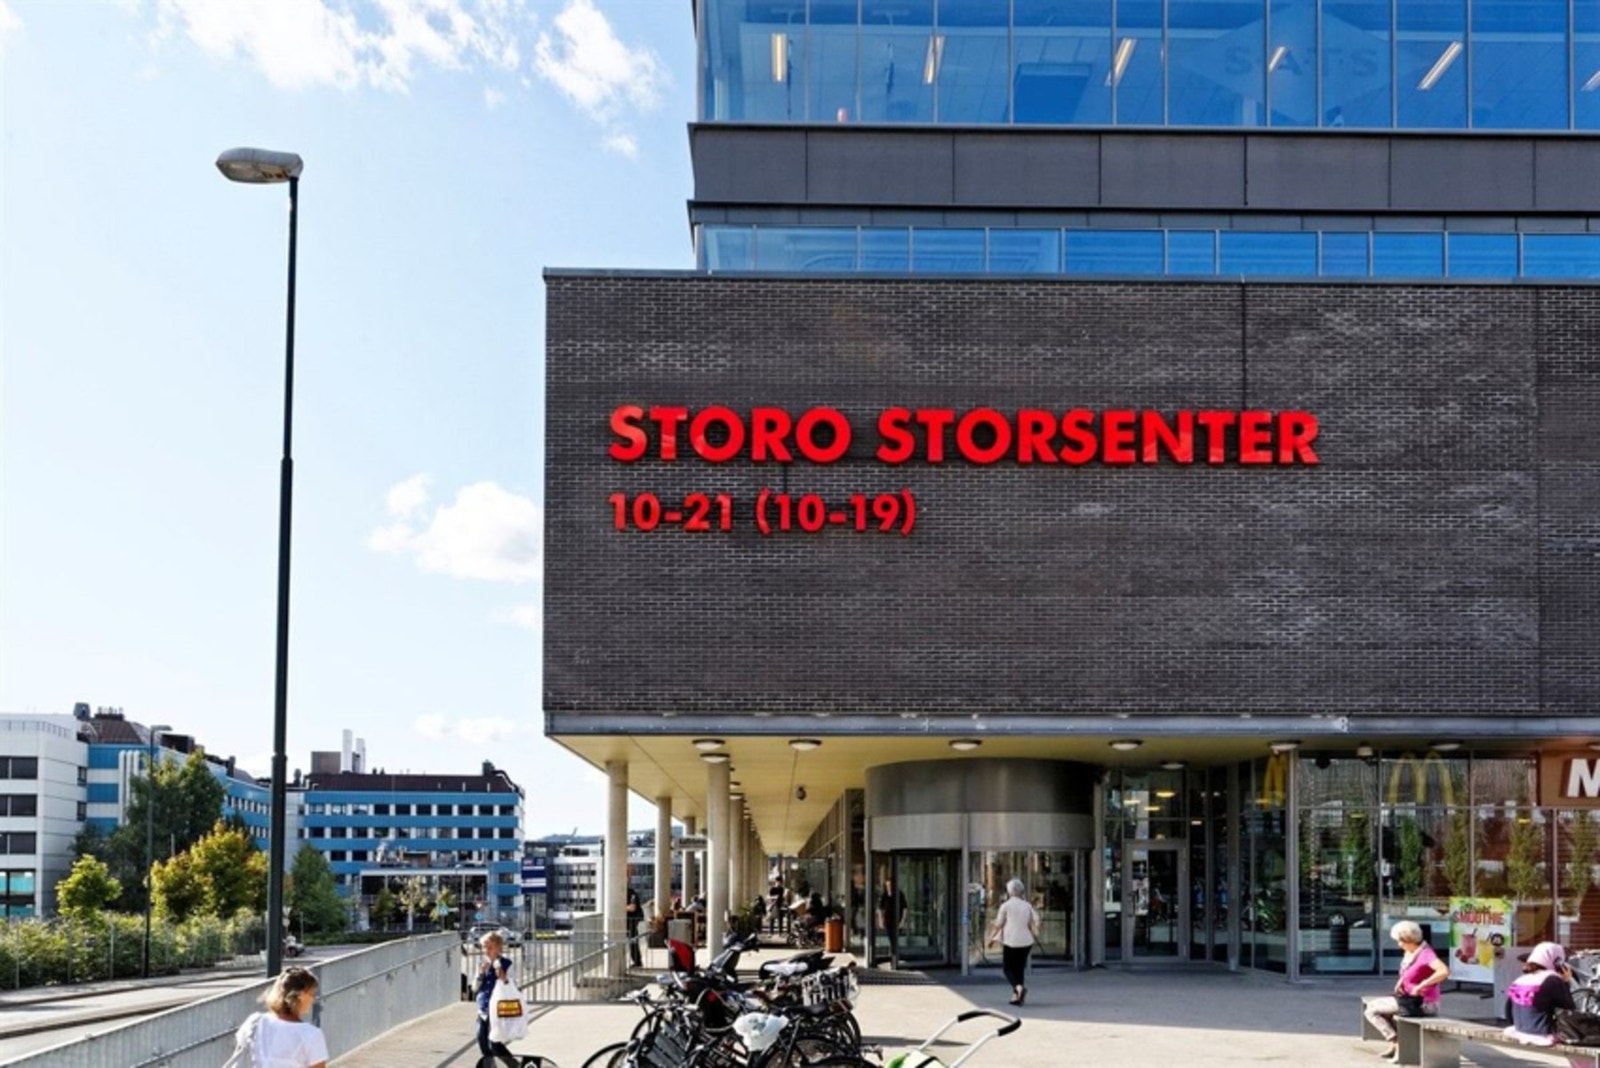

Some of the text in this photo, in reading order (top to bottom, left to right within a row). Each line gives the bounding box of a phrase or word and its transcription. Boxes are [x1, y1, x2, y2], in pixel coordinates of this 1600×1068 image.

[609, 405, 1320, 464] STORO STORSENTER
[610, 488, 915, 535] 10-21 (10-19)
